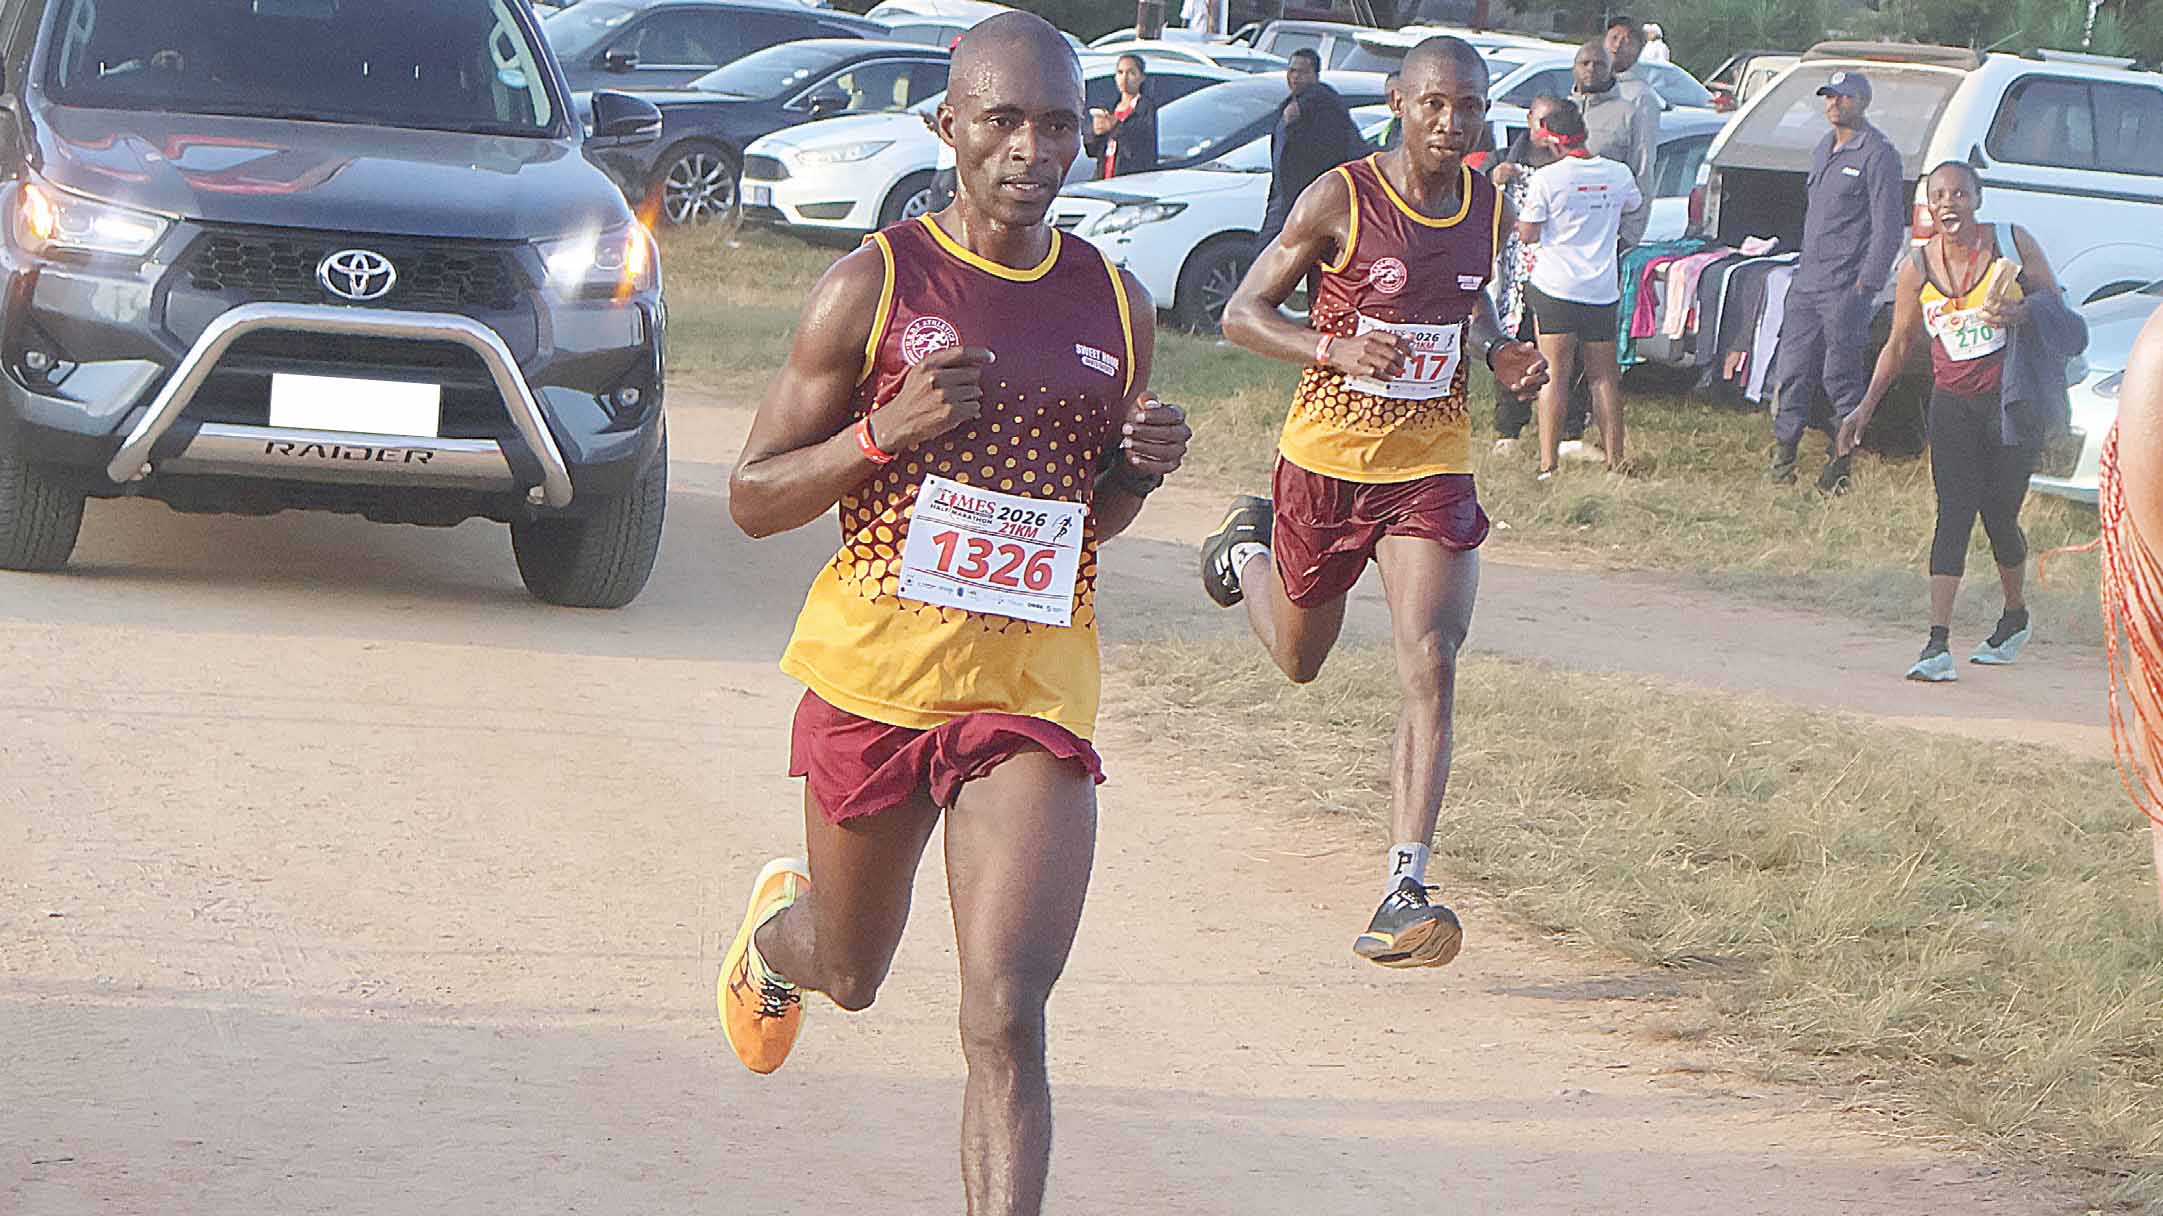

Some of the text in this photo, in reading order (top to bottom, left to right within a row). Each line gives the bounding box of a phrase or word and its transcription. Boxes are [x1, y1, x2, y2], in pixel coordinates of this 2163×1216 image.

[1955, 325, 1993, 348] 270
[1075, 343, 1102, 360] SWEET
[265, 441, 434, 464] RAIDER
[930, 503, 950, 513] HALF
[951, 509, 993, 525] MARATHON
[937, 488, 1049, 527] TIMES 2026
[998, 522, 1039, 539] 21KM
[932, 530, 1057, 592] 1326
